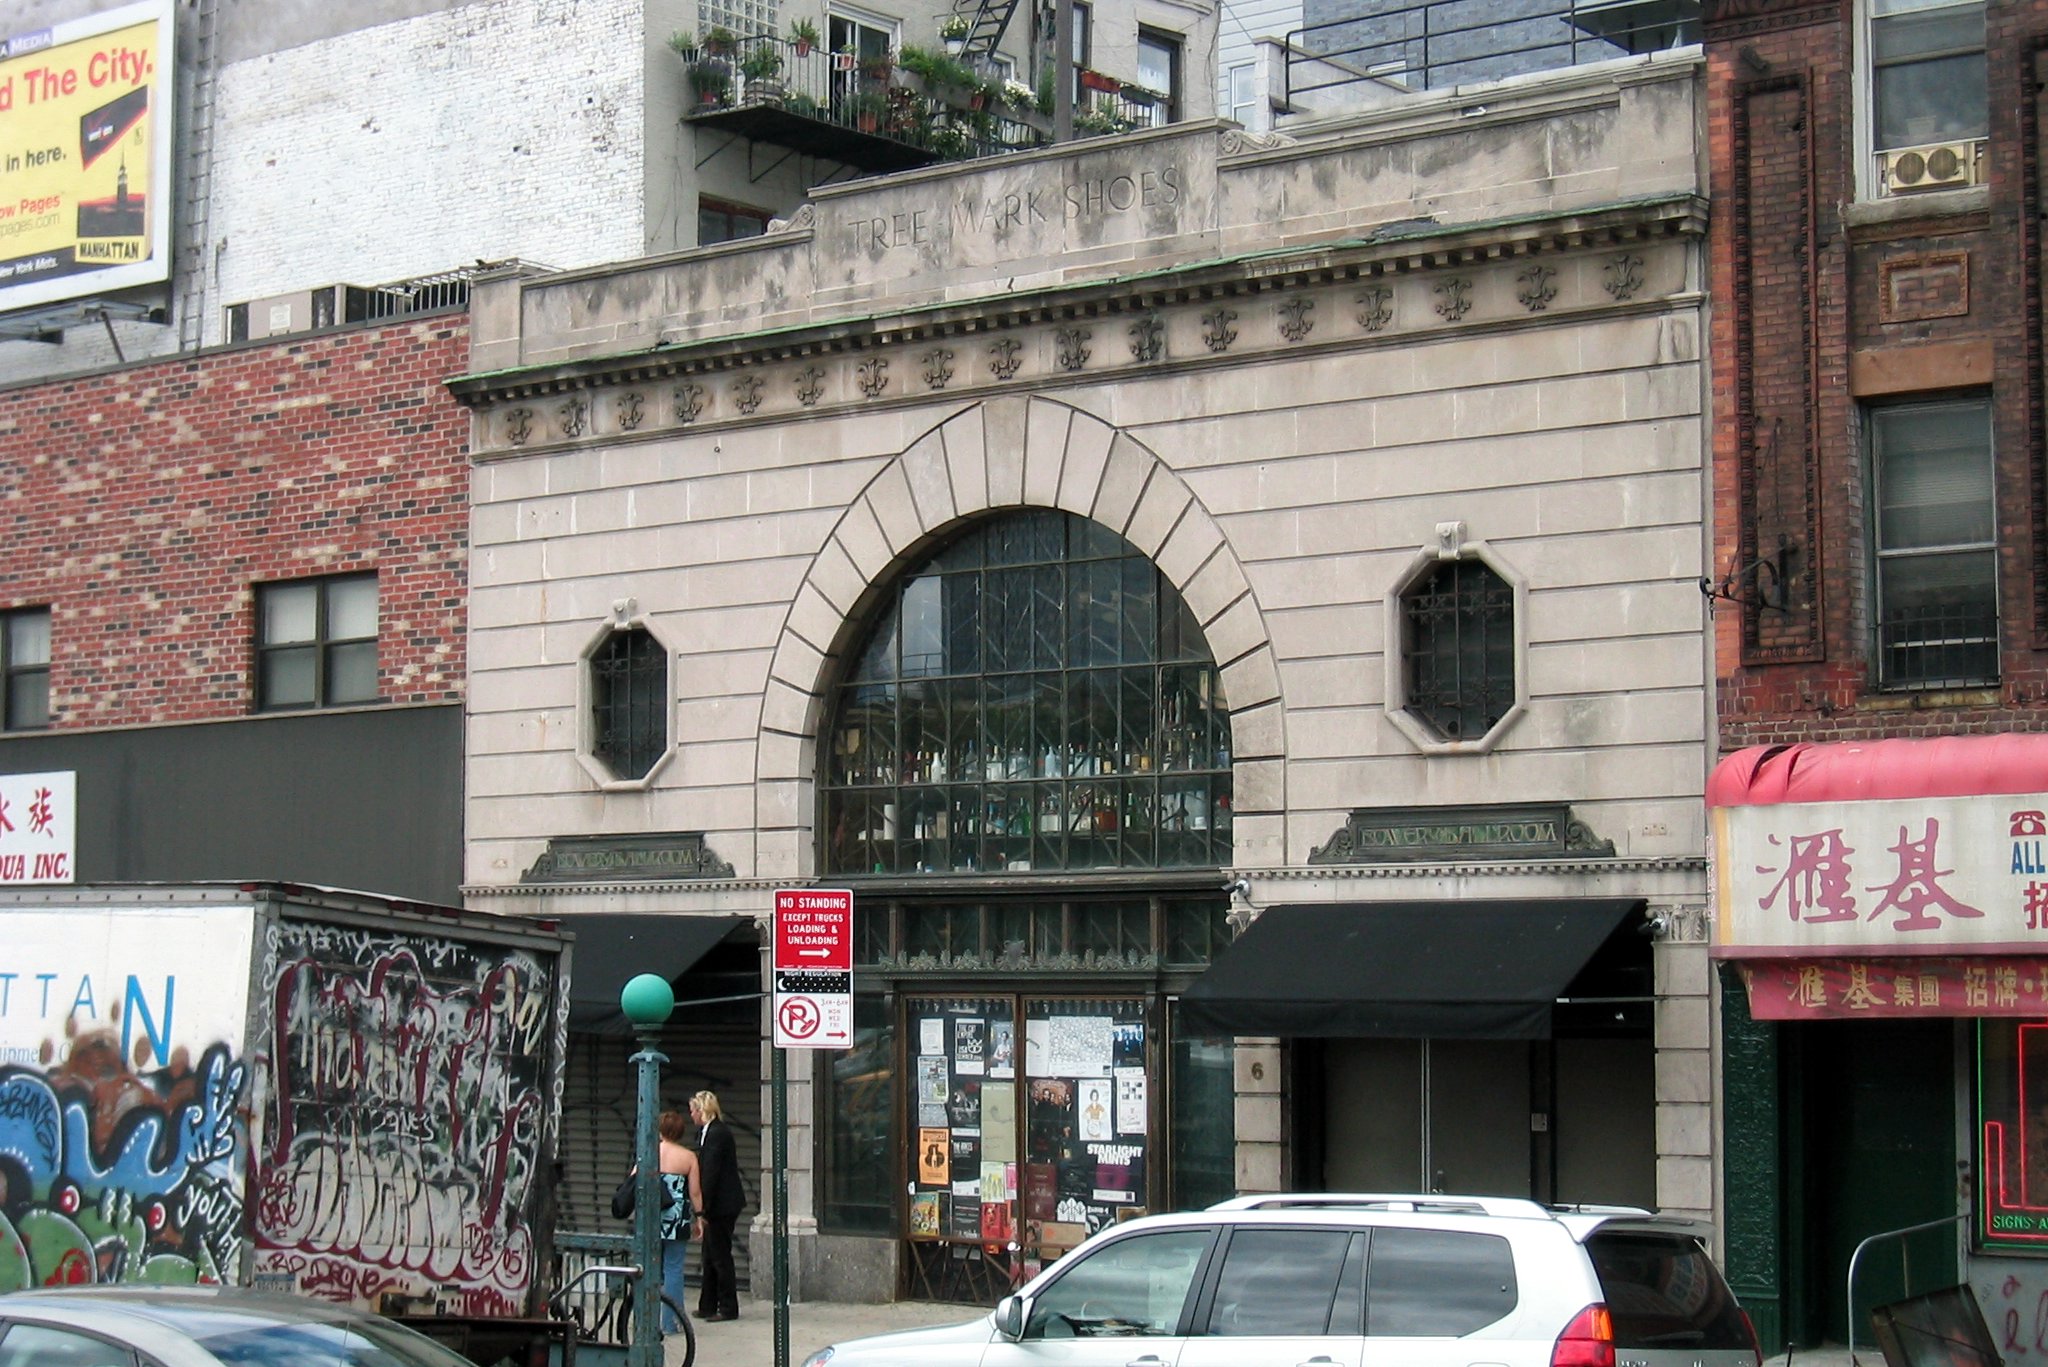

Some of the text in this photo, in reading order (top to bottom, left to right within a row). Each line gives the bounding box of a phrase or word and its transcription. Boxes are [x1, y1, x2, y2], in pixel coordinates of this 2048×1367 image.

[12, 33, 51, 54] MEDIA
[24, 67, 77, 104] The
[88, 47, 153, 87] City.
[6, 146, 66, 172] in here.
[20, 195, 61, 215] Pages
[848, 168, 1180, 252] TREE MARK SHOES
[80, 241, 139, 259] MANHATTAN
[0, 852, 69, 880] UA INC.
[2011, 841, 2045, 875] ALL
[780, 897, 847, 909] NO STANDING
[782, 913, 843, 923] EXCEPT TRUCKS
[787, 925, 838, 934] LOADING &
[787, 936, 838, 945] UNLOADING
[1251, 1062, 1264, 1081] 6
[1087, 1144, 1143, 1158] STARLIGHT
[1993, 1215, 2033, 1229] SIGNS
